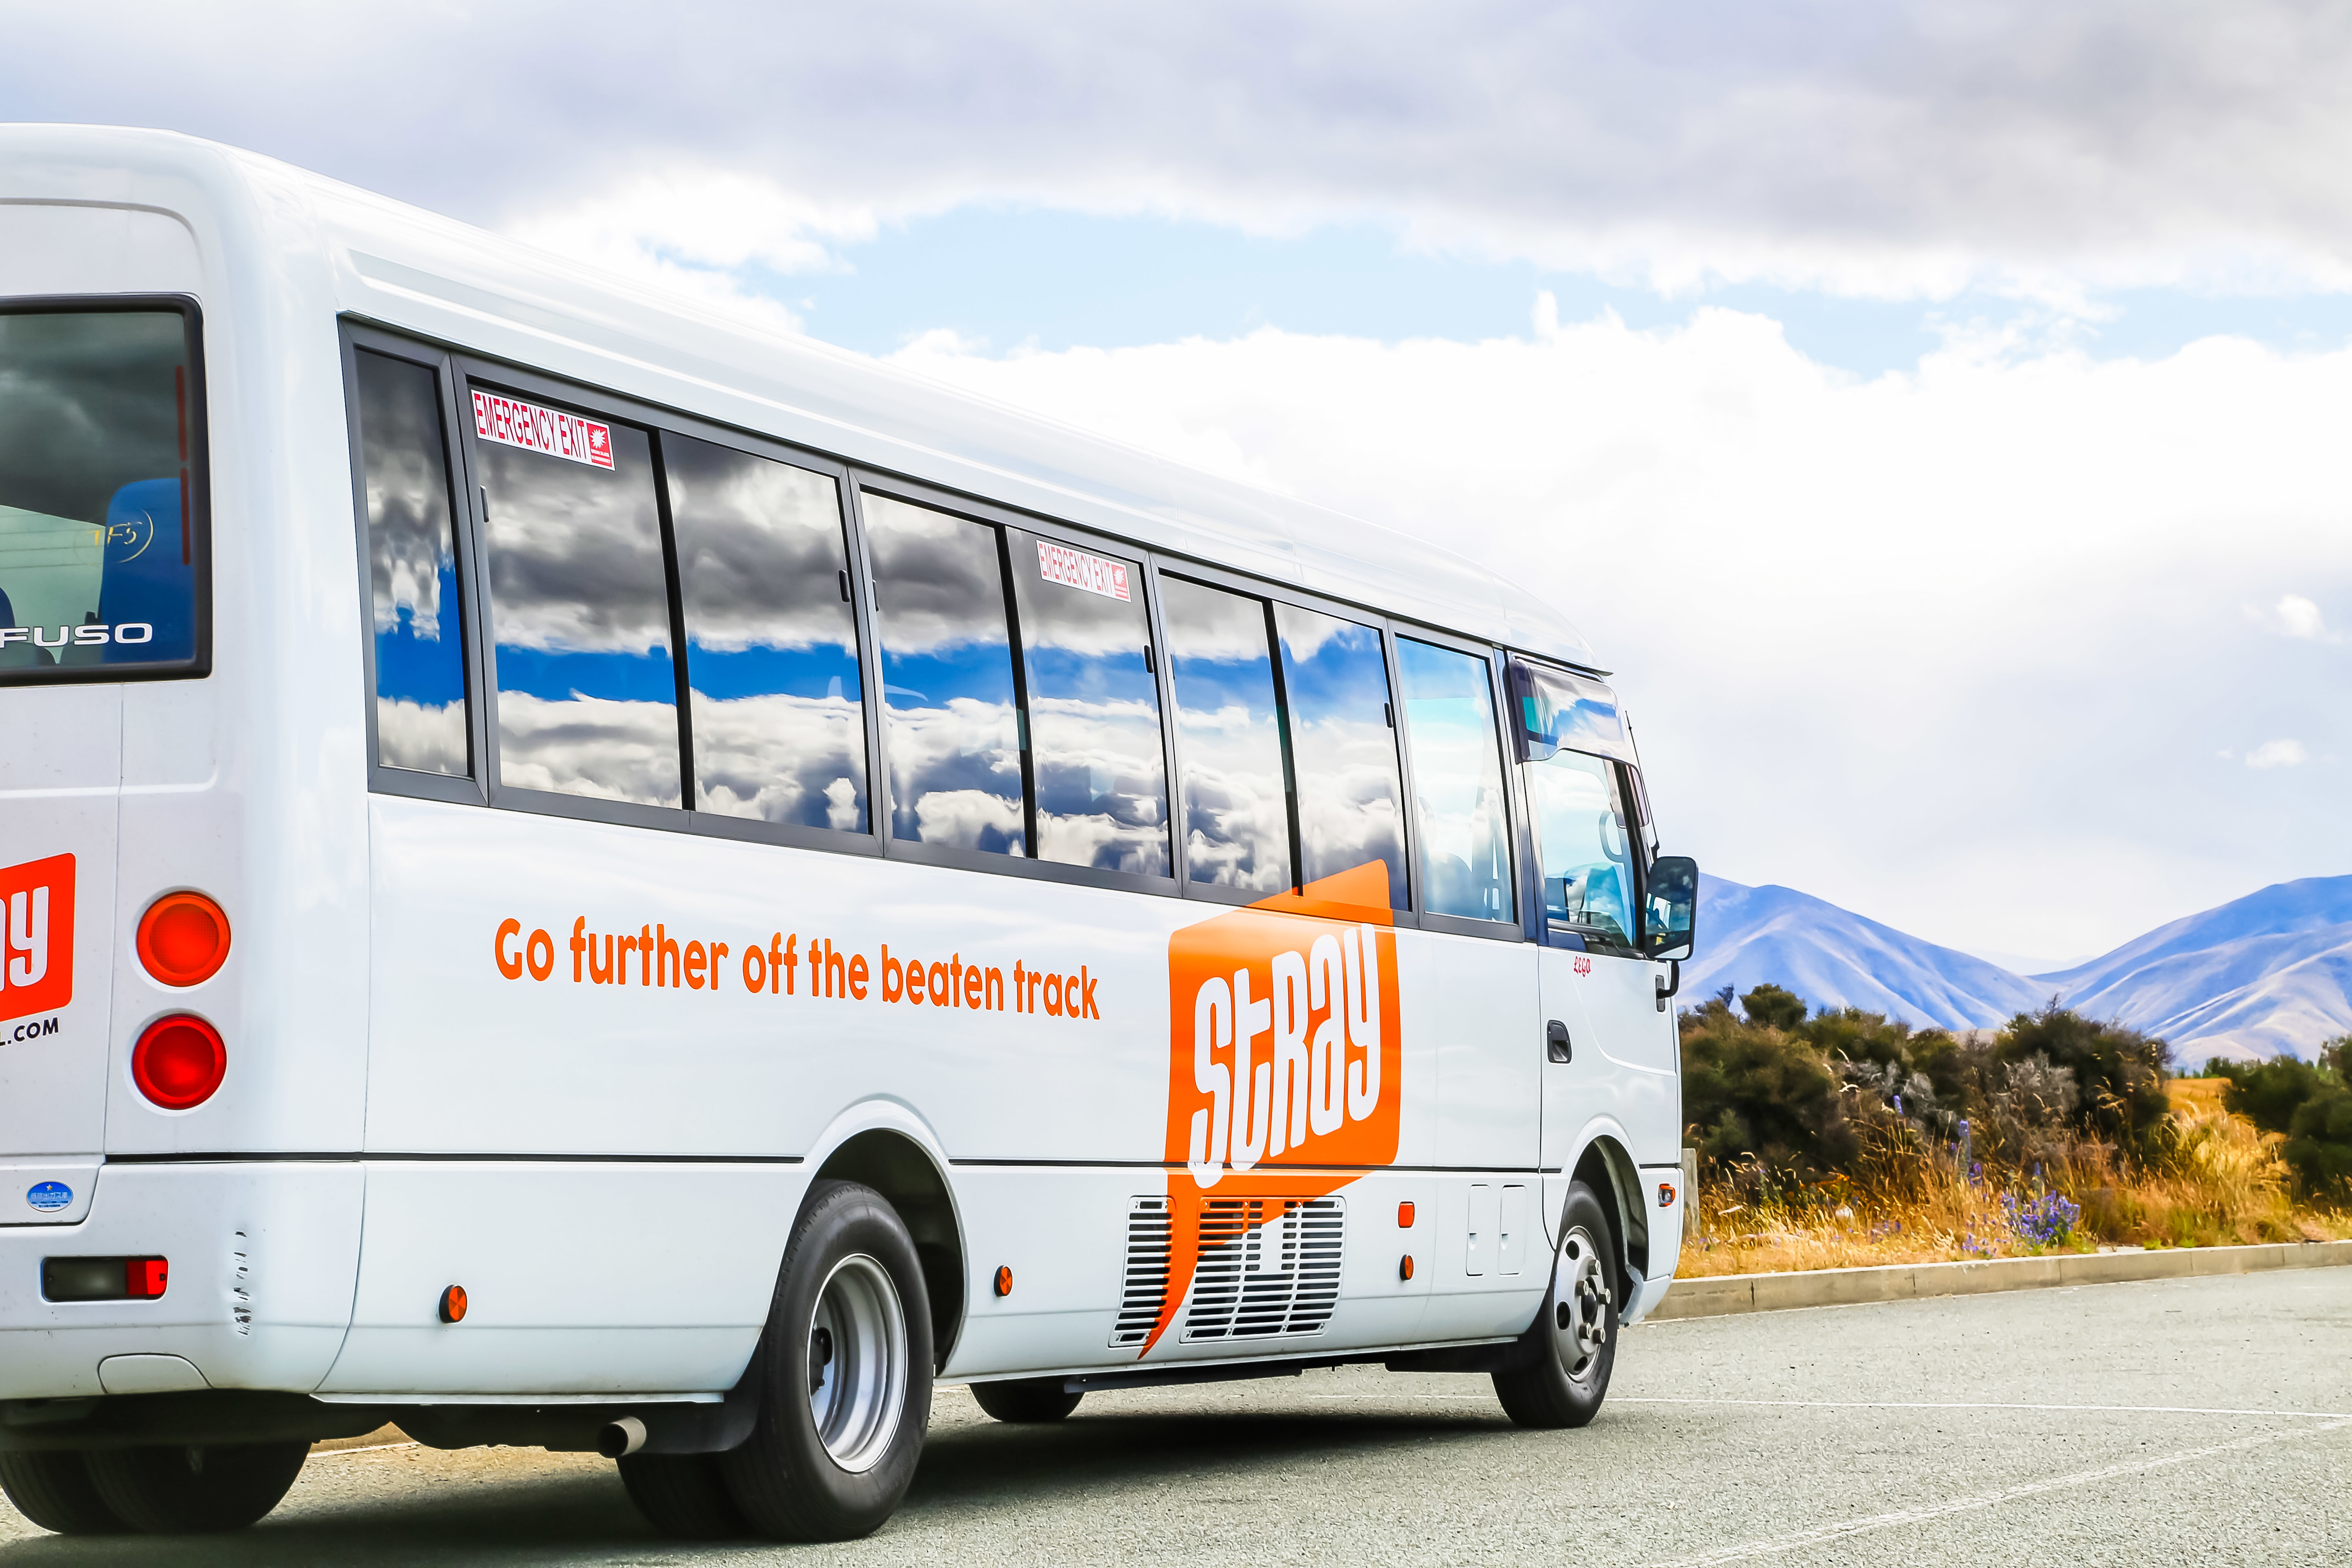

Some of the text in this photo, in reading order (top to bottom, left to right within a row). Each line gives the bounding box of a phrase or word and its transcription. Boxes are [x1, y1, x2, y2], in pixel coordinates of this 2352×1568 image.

[474, 393, 587, 460] EMERGENCY EXIT
[1038, 543, 1112, 594] EMERGENCY EXIT
[0, 623, 153, 648] FUSO
[0, 885, 49, 992] y
[495, 915, 1100, 1020] Go further off the beaten track
